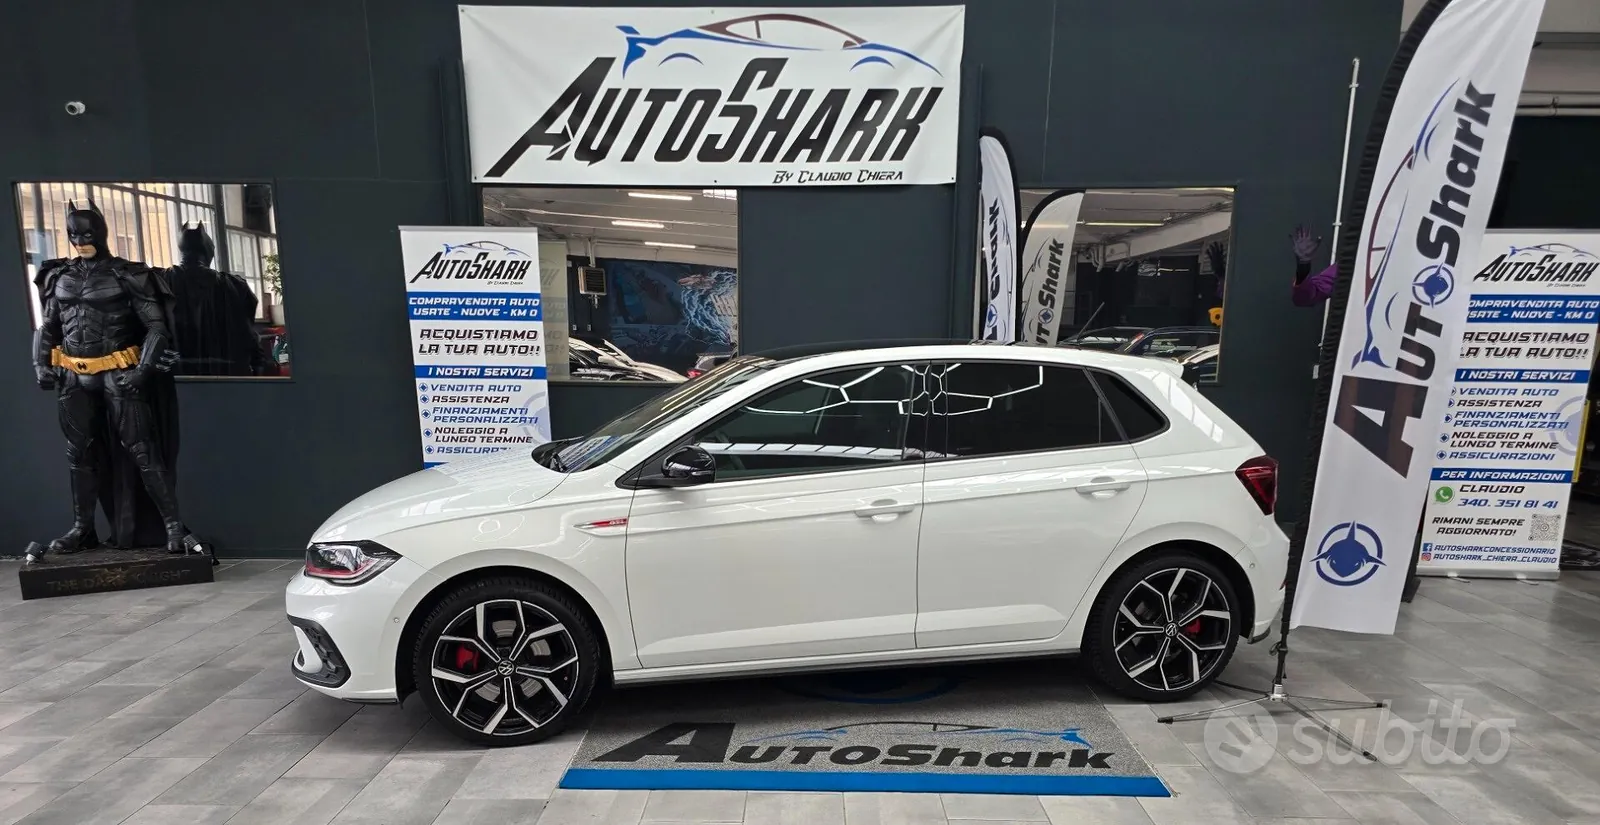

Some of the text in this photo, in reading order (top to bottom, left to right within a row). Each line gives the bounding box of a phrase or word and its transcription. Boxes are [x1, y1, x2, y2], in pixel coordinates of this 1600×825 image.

[773, 169, 903, 184] BY CLAUDIO CHIERA
[409, 251, 532, 284] AUTOSHARK
[1473, 254, 1600, 282] AUTOSHARK
[409, 297, 540, 307] COMPRAVENDITA AUTO
[1468, 300, 1599, 309] OMPRAVENDITA AUTO
[413, 308, 450, 316] USATE
[461, 308, 500, 316] NUOVE
[510, 309, 526, 317] KM
[1511, 311, 1555, 319] NUOVE
[420, 329, 539, 341] ACQUISTIAMO
[1462, 331, 1590, 343] ACQUISTIAMO
[418, 344, 541, 356] LA TUA AUTO!!
[1485, 347, 1521, 359] TUA
[1525, 348, 1588, 360] AUTO!!
[428, 367, 533, 377] I NOSTRI SERVIZI
[1460, 370, 1576, 381] I NOSTRI SERVIZI
[430, 384, 522, 392] VENDITA AUTO
[1459, 388, 1559, 397] VENDITA AUTO
[432, 395, 510, 404] ASSISTENZA
[1456, 400, 1542, 408] ASSISTENZA
[432, 406, 528, 415] FINANZIAMENTI
[433, 415, 538, 424] PERSONALIZZATI
[1454, 411, 1561, 420] FINANZIAMENTI
[1453, 420, 1569, 429] PERSONALIZZATI
[434, 427, 508, 435] NOLEGGIO A
[1451, 431, 1533, 440] NOLEGGIO A
[435, 435, 533, 444] LUNGO TERMINE
[1450, 441, 1559, 450] LUNGO TERMINE
[1448, 452, 1556, 461] ASSICURAZIONI
[1440, 471, 1565, 481] PER INFORMAZIONI
[1459, 484, 1525, 494] CLAUDIO
[1457, 498, 1559, 509] 340. 351 81 41
[1432, 517, 1525, 526] RIMANI SEMPRE
[1436, 527, 1516, 536] AGGIORNATO!
[1434, 544, 1556, 555] AUTOSHARKCONCESSIONARIO
